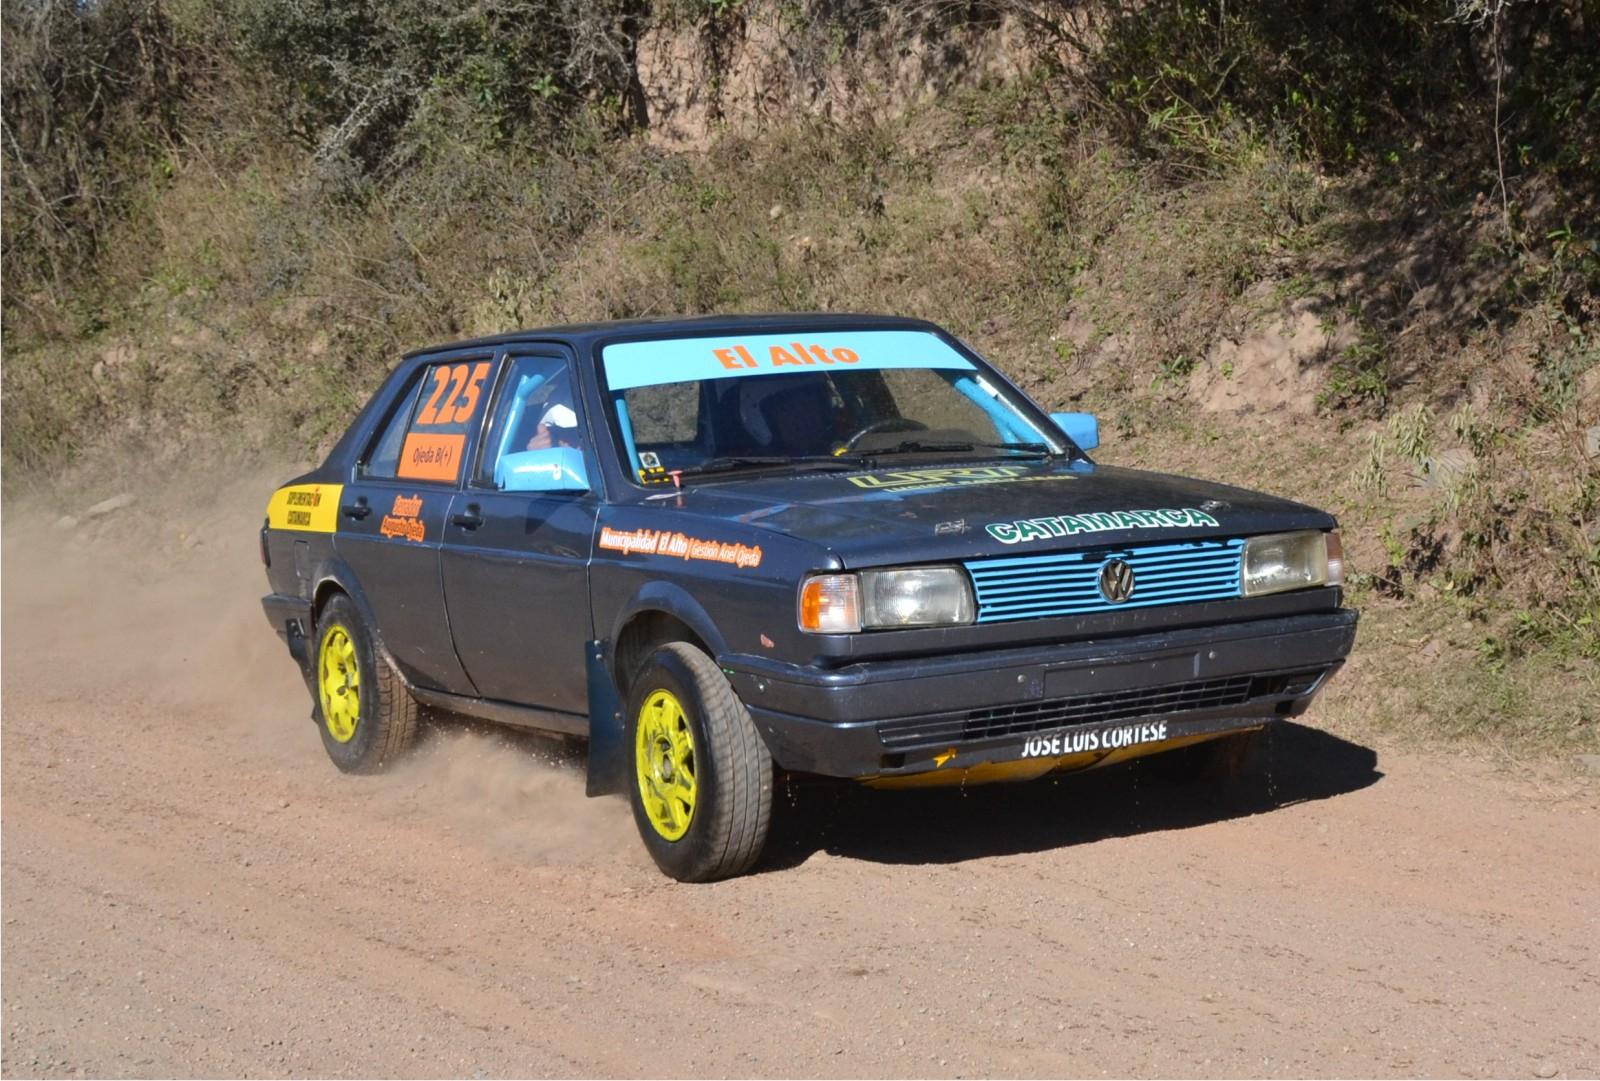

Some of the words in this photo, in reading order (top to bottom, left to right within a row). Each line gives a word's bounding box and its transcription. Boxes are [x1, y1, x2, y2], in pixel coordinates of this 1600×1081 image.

[712, 345, 759, 369] El
[768, 342, 860, 367] Alto
[416, 363, 491, 424] 225
[413, 447, 435, 467] Ojeda
[985, 508, 1220, 544] CATAMARCA
[600, 527, 658, 554] Municipalidad
[657, 531, 671, 552] El
[669, 533, 689, 555] Alto
[735, 544, 762, 568] Ojeda
[1063, 728, 1100, 753] LUIS
[1101, 720, 1168, 749] CORTESE
